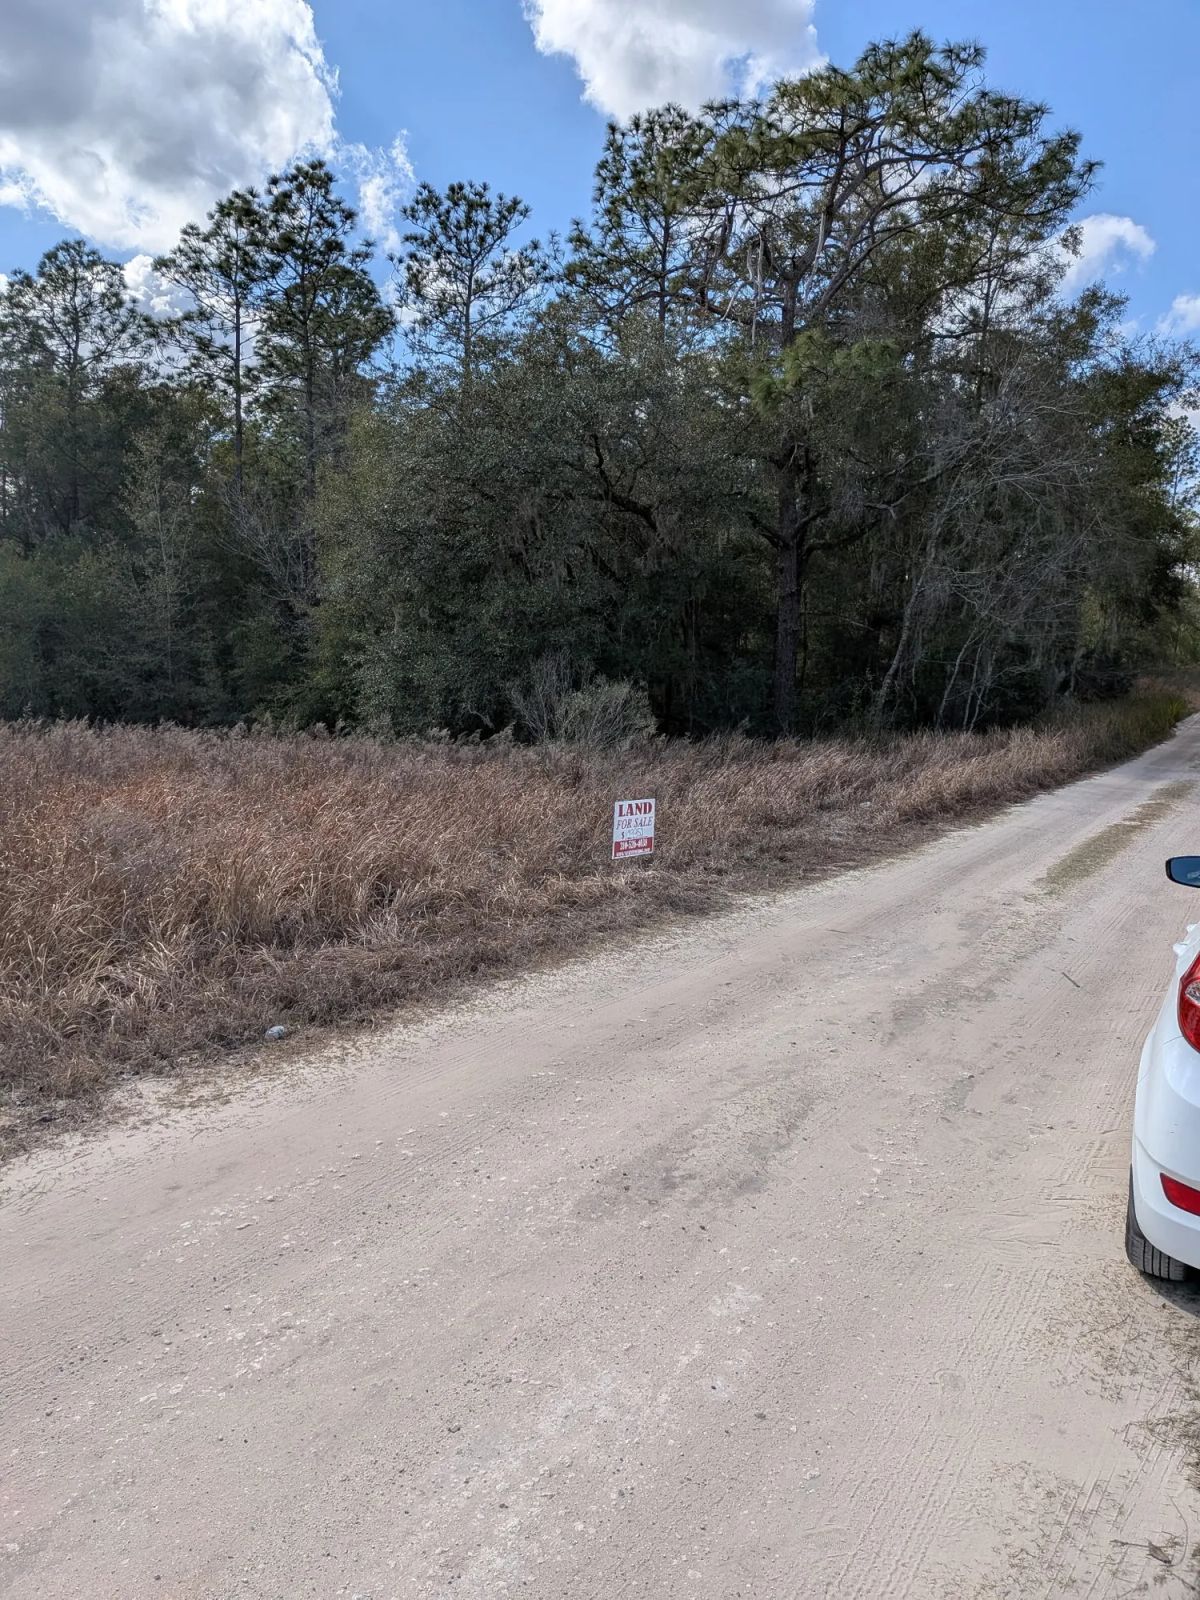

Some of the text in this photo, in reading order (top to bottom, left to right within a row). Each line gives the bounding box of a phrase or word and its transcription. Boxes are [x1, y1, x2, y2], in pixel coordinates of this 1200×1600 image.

[618, 802, 653, 817] LAND
[616, 816, 653, 830] FOR SALE
